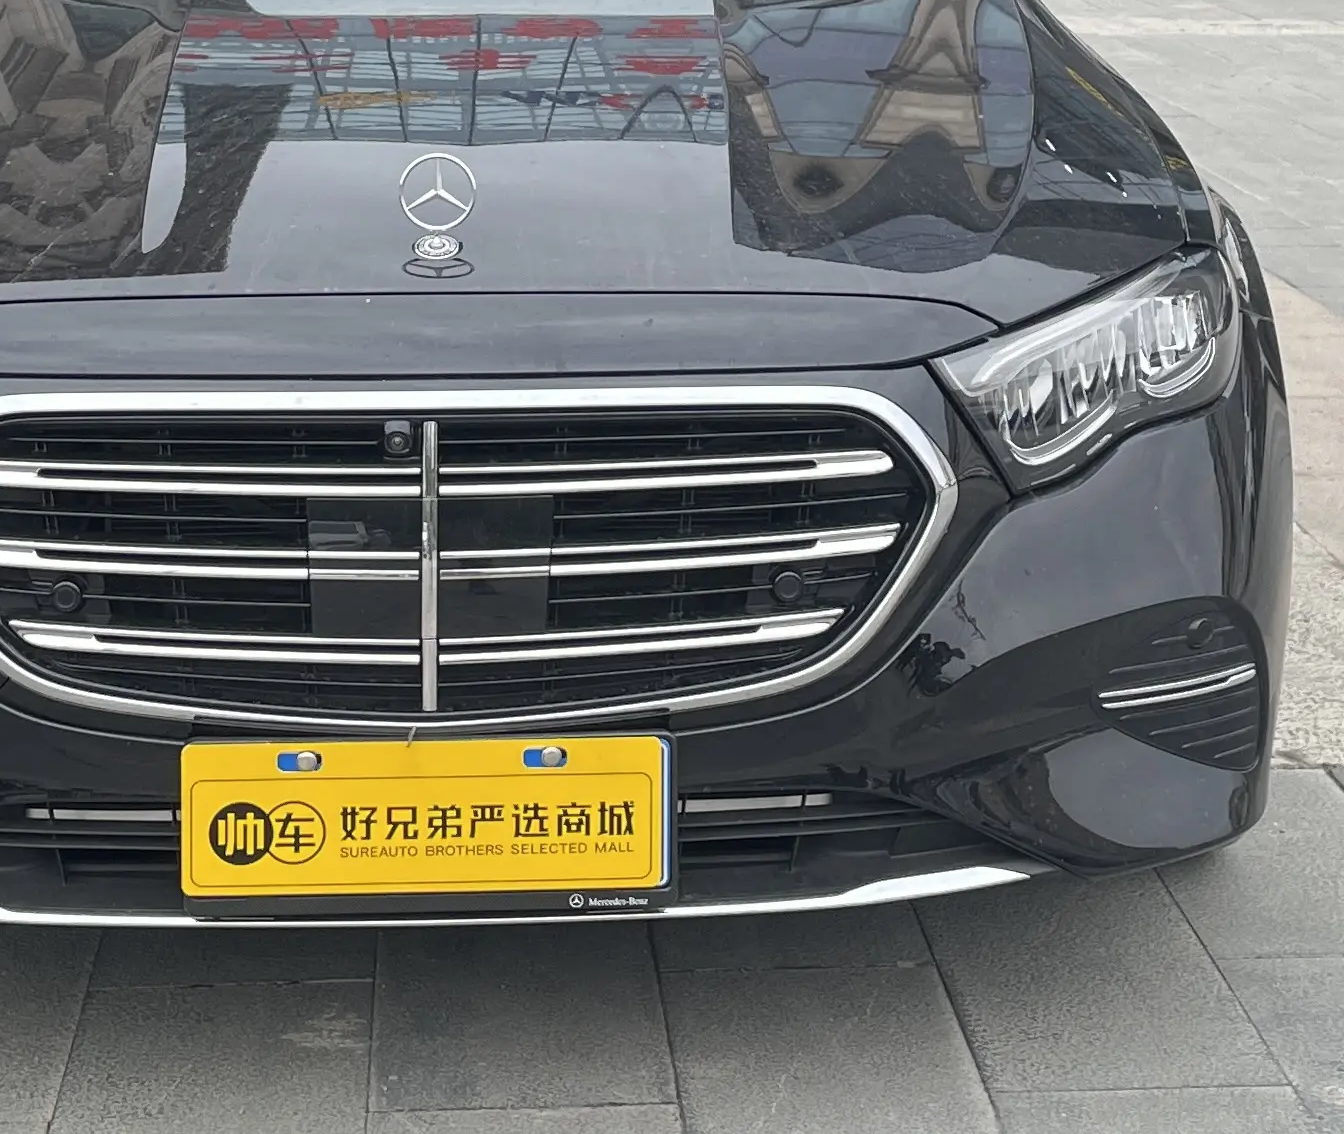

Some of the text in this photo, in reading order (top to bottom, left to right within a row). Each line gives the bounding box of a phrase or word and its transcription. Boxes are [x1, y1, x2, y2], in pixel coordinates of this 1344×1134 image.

[213, 800, 635, 861] 帅车 好兄弟严选商城
[340, 841, 635, 858] SUREAUTO BROTHERS SELECTED MALL
[588, 896, 649, 907] Mercedes-Benz
